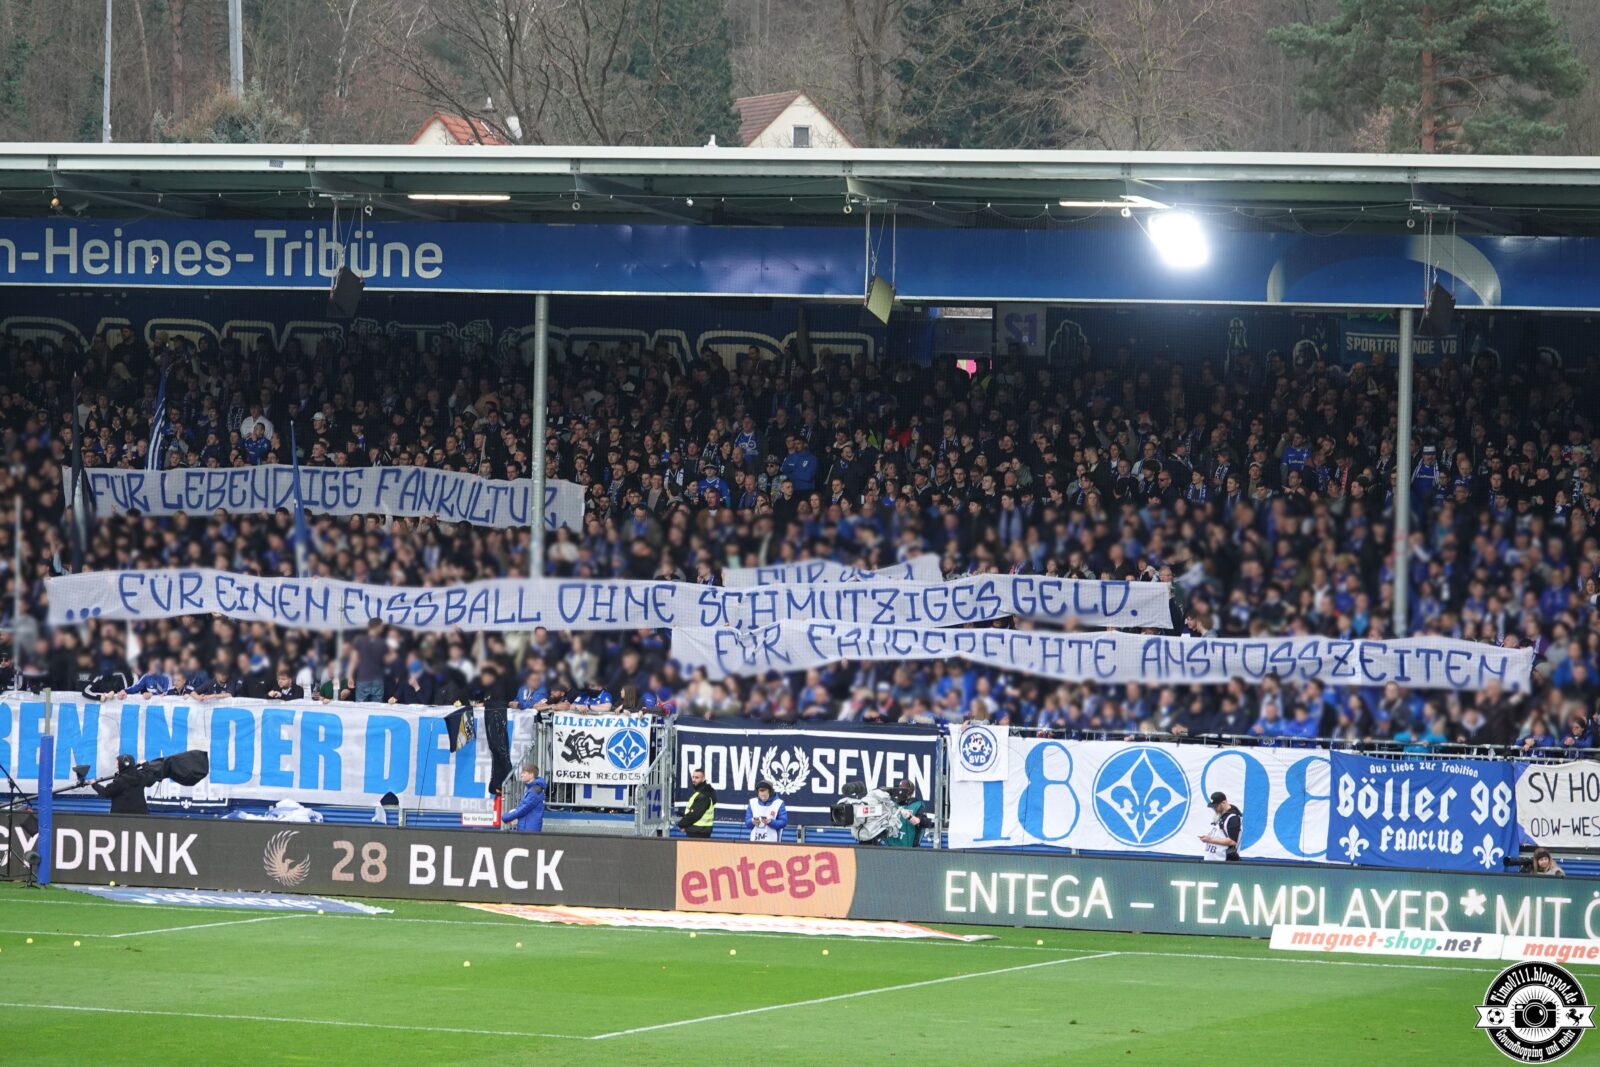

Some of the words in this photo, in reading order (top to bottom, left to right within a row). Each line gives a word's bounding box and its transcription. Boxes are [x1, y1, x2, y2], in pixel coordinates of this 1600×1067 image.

[1346, 336, 1435, 355] SPORTFRNDE
[91, 472, 150, 512] FÜR
[160, 467, 363, 511] LEBENDIGE
[119, 572, 203, 614] FÜR
[215, 575, 330, 622] EINEN
[343, 585, 540, 626] FUSSBALL
[557, 583, 676, 623] OHNE
[698, 581, 1002, 630] SCHMUTZIGES
[1012, 578, 1138, 617] GELD.
[554, 715, 650, 728] LILIENFANS
[119, 704, 190, 782] IN
[210, 707, 343, 791] DER
[969, 754, 986, 766] SVD
[1370, 764, 1387, 774] Aus
[1441, 762, 1479, 778] Tradition
[556, 770, 591, 779] GEGEN
[680, 744, 762, 791] ROW
[811, 748, 932, 801] SEVEN
[1528, 772, 1558, 803] SV
[1569, 772, 1600, 803] HO
[647, 789, 662, 819] 14
[1337, 772, 1457, 823] Böller
[1470, 780, 1512, 827] 98
[55, 828, 198, 875] DRINK
[332, 840, 387, 883] 28
[409, 844, 564, 891] BLACK
[681, 850, 840, 905] entega
[945, 870, 1113, 919] ENTEGA
[1170, 880, 1450, 932] TEAMPLAYER
[1496, 894, 1571, 938] MIT
[1291, 930, 1482, 954] magnet-shop.net
